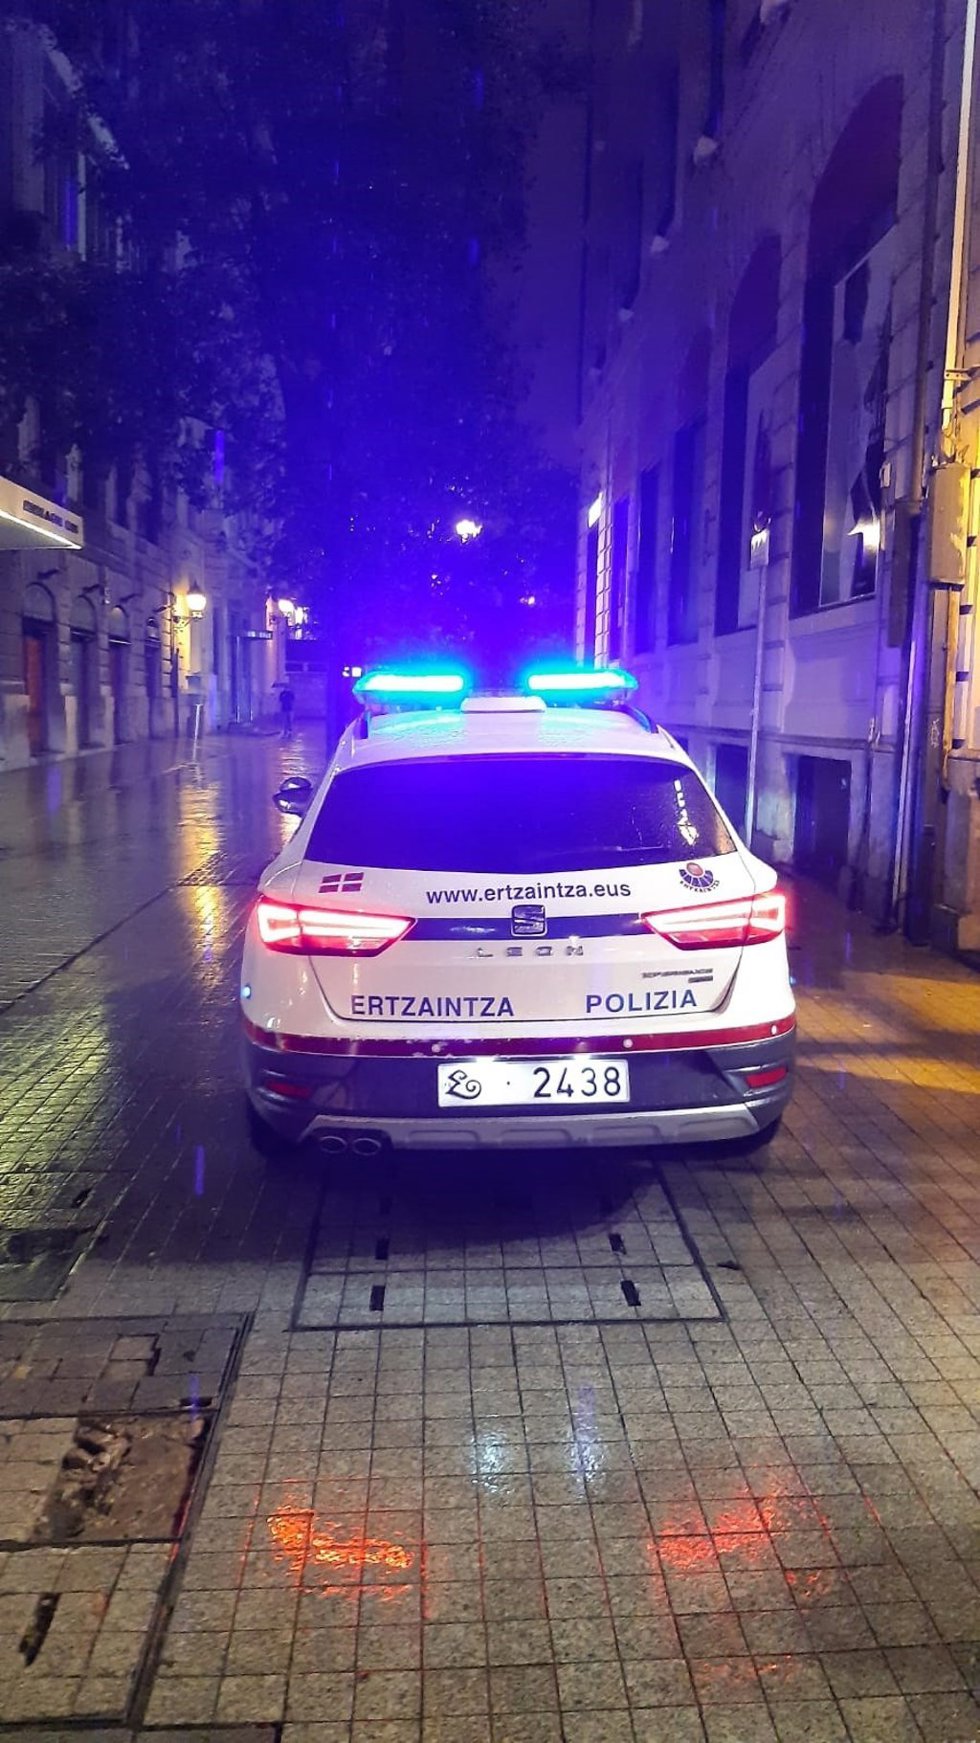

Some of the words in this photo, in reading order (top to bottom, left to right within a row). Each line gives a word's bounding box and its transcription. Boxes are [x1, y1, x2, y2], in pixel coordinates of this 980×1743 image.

[426, 882, 631, 904] www.ertzaintza.eus
[351, 994, 514, 1017] ERTZAINTZA
[586, 989, 697, 1013] POLIZIA
[533, 1066, 621, 1098] 2438
